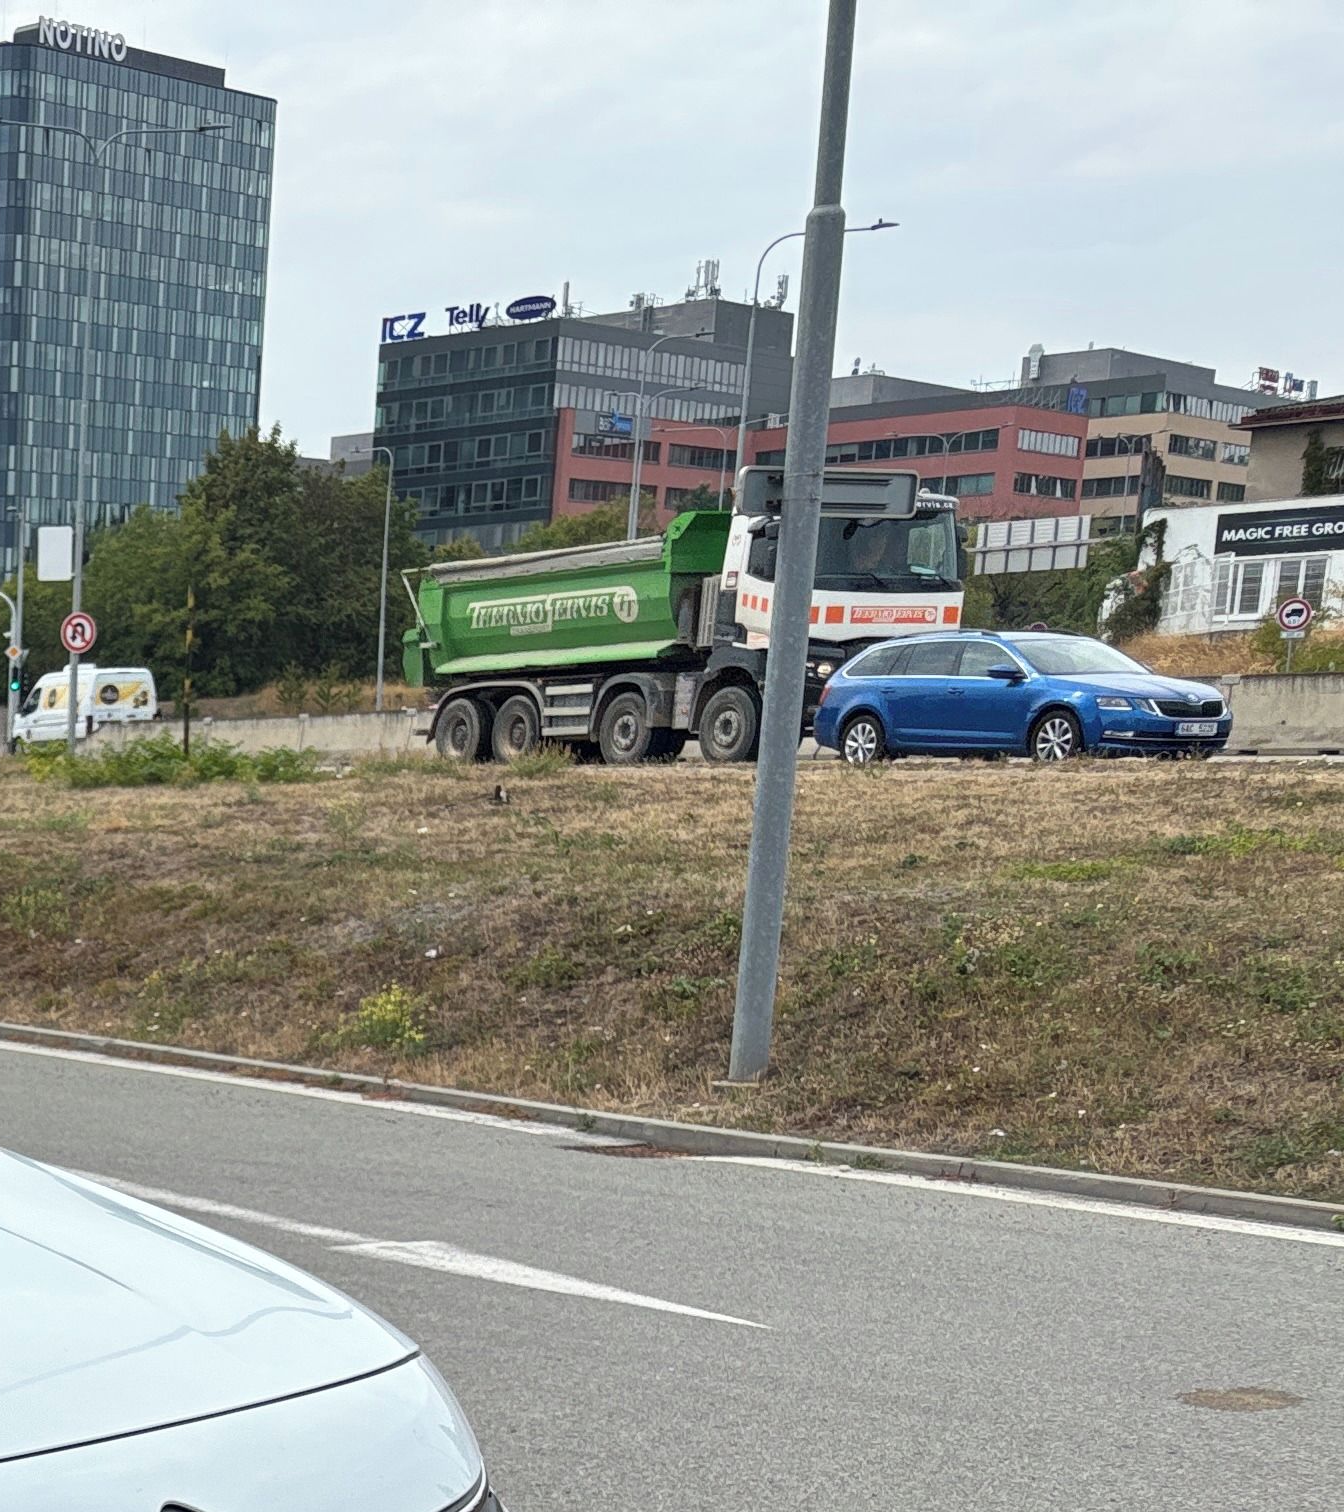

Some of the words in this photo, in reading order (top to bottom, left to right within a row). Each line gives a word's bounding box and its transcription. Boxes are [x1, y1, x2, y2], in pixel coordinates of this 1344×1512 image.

[39, 15, 127, 62] NOTINO
[445, 303, 490, 328] Telly
[508, 301, 552, 314] HARTMANN
[381, 312, 426, 343] ICZ
[1222, 527, 1272, 541] MAGIC
[1274, 524, 1309, 537] FREE
